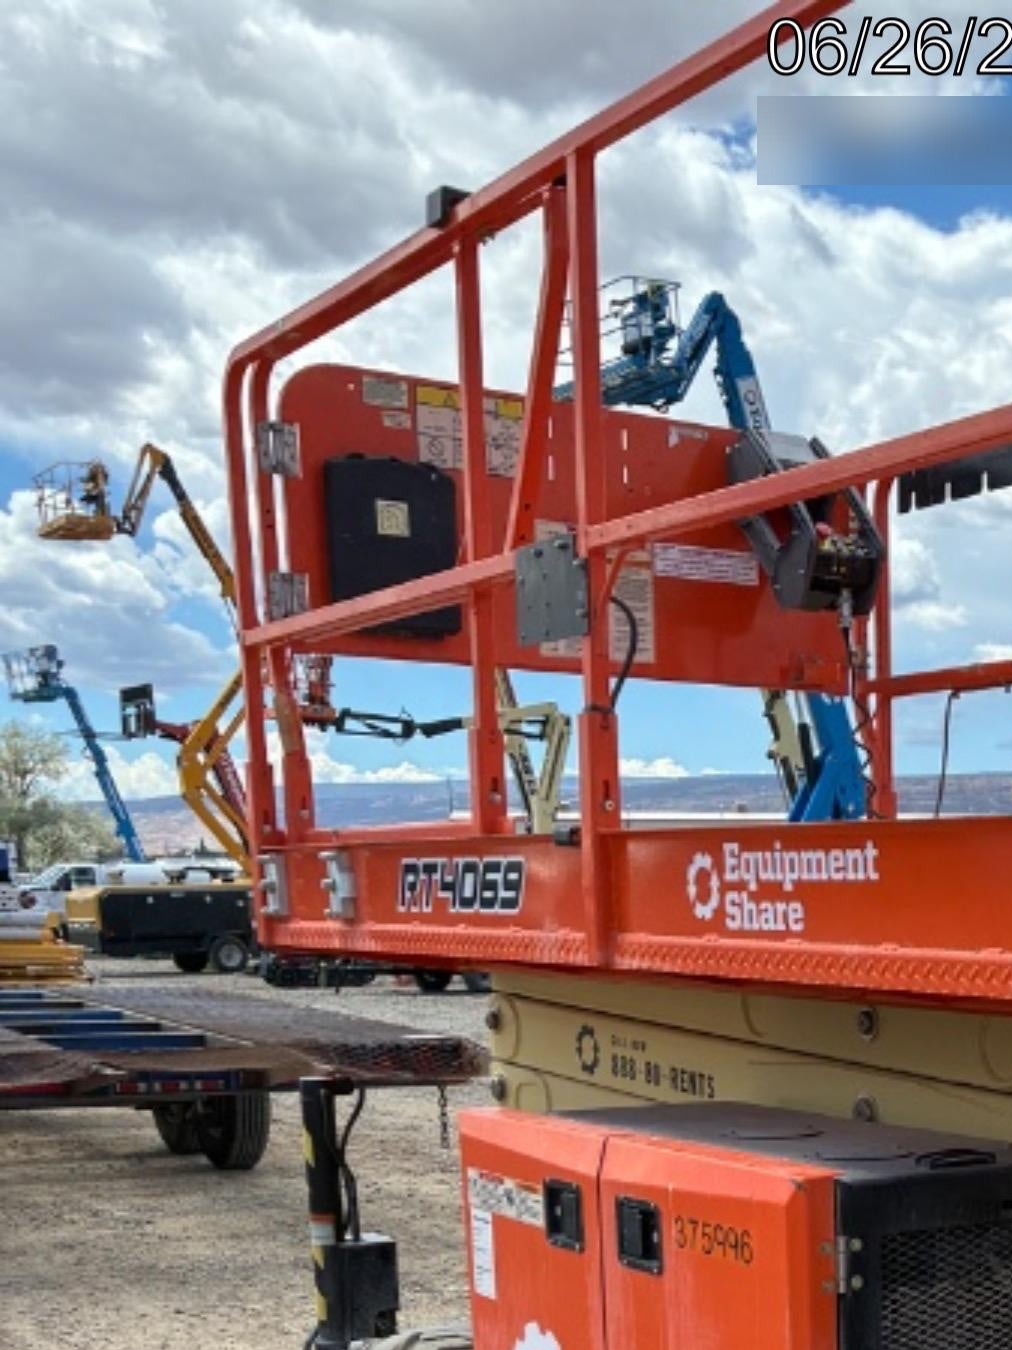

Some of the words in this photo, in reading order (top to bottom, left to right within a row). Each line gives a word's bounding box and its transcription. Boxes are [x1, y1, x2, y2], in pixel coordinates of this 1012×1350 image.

[398, 857, 525, 914] RT4069
[724, 840, 879, 889] Equipment
[725, 897, 805, 933] Share
[674, 1215, 754, 1265] 375996
